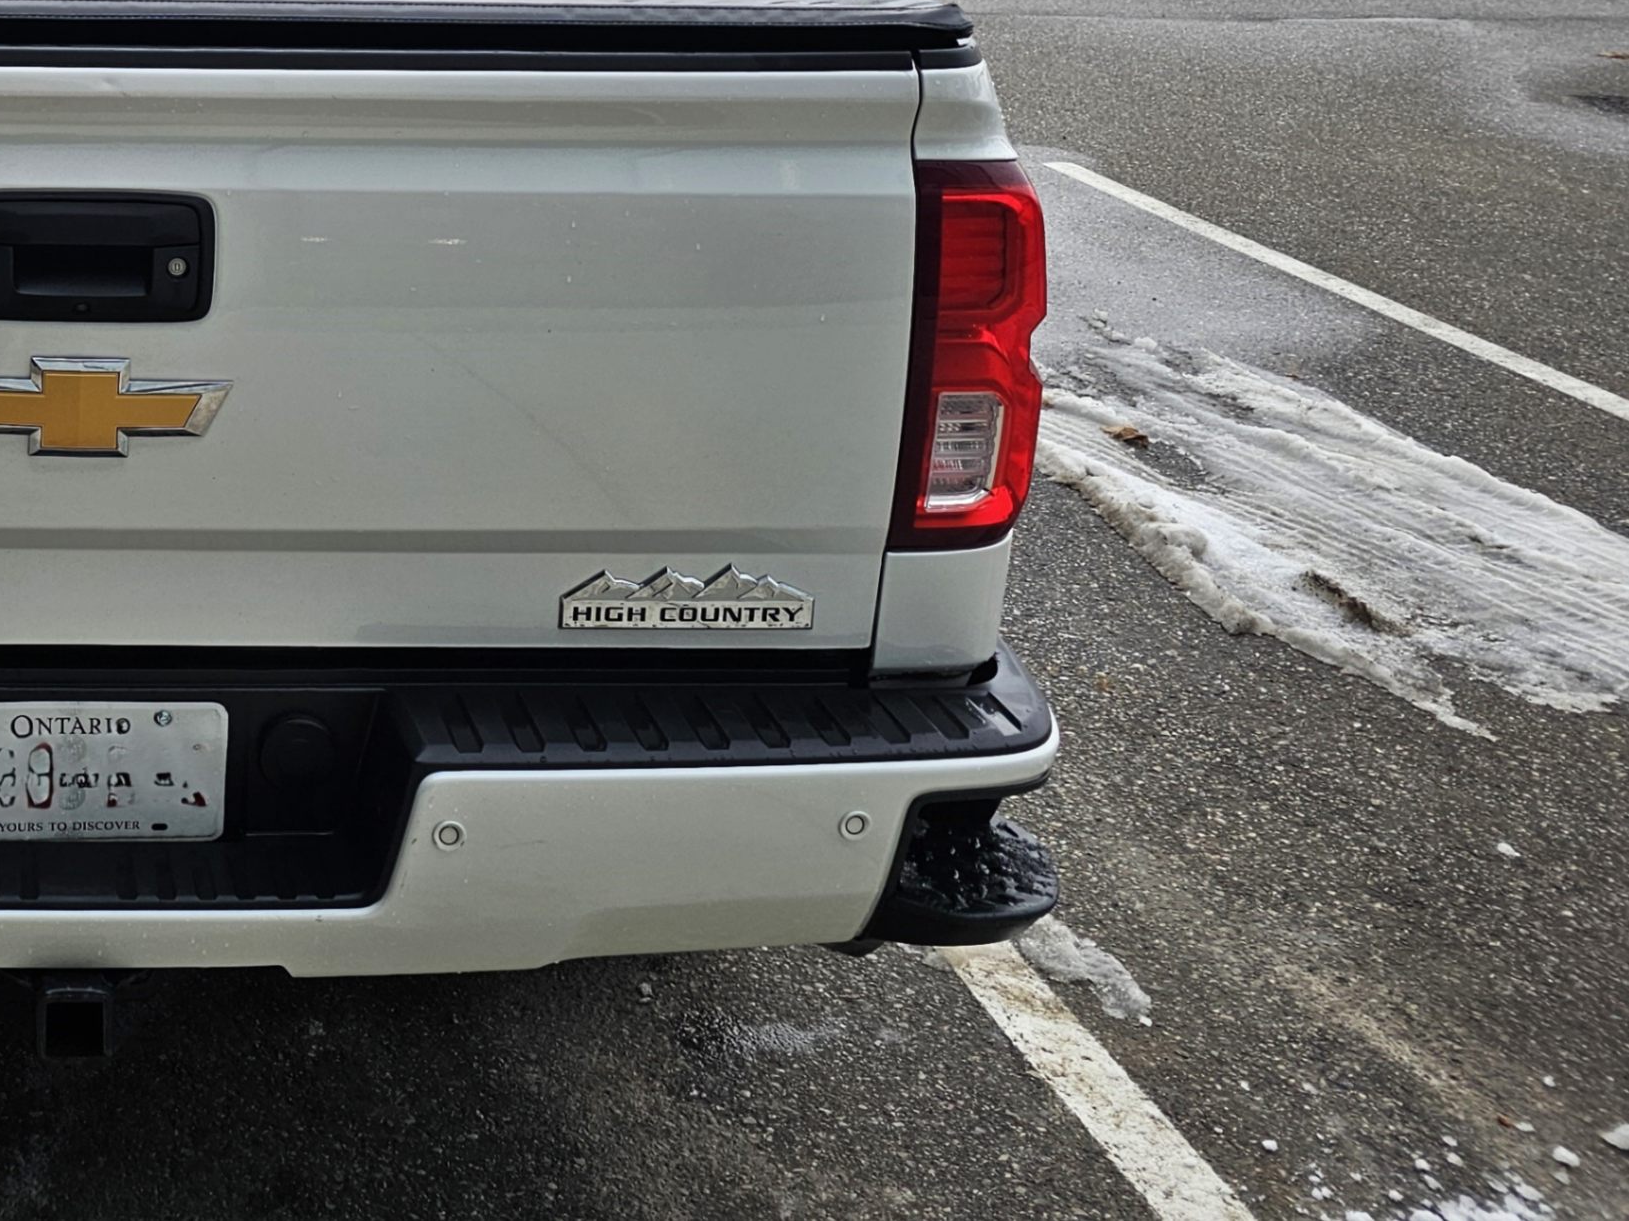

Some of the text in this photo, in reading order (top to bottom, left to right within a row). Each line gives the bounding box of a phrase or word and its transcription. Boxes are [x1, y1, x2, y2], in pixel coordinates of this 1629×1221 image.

[572, 605, 804, 623] HIGH COUNTRY
[10, 714, 131, 739] ONTARIO
[48, 821, 68, 832] TO
[72, 820, 140, 832] DISCOVER
